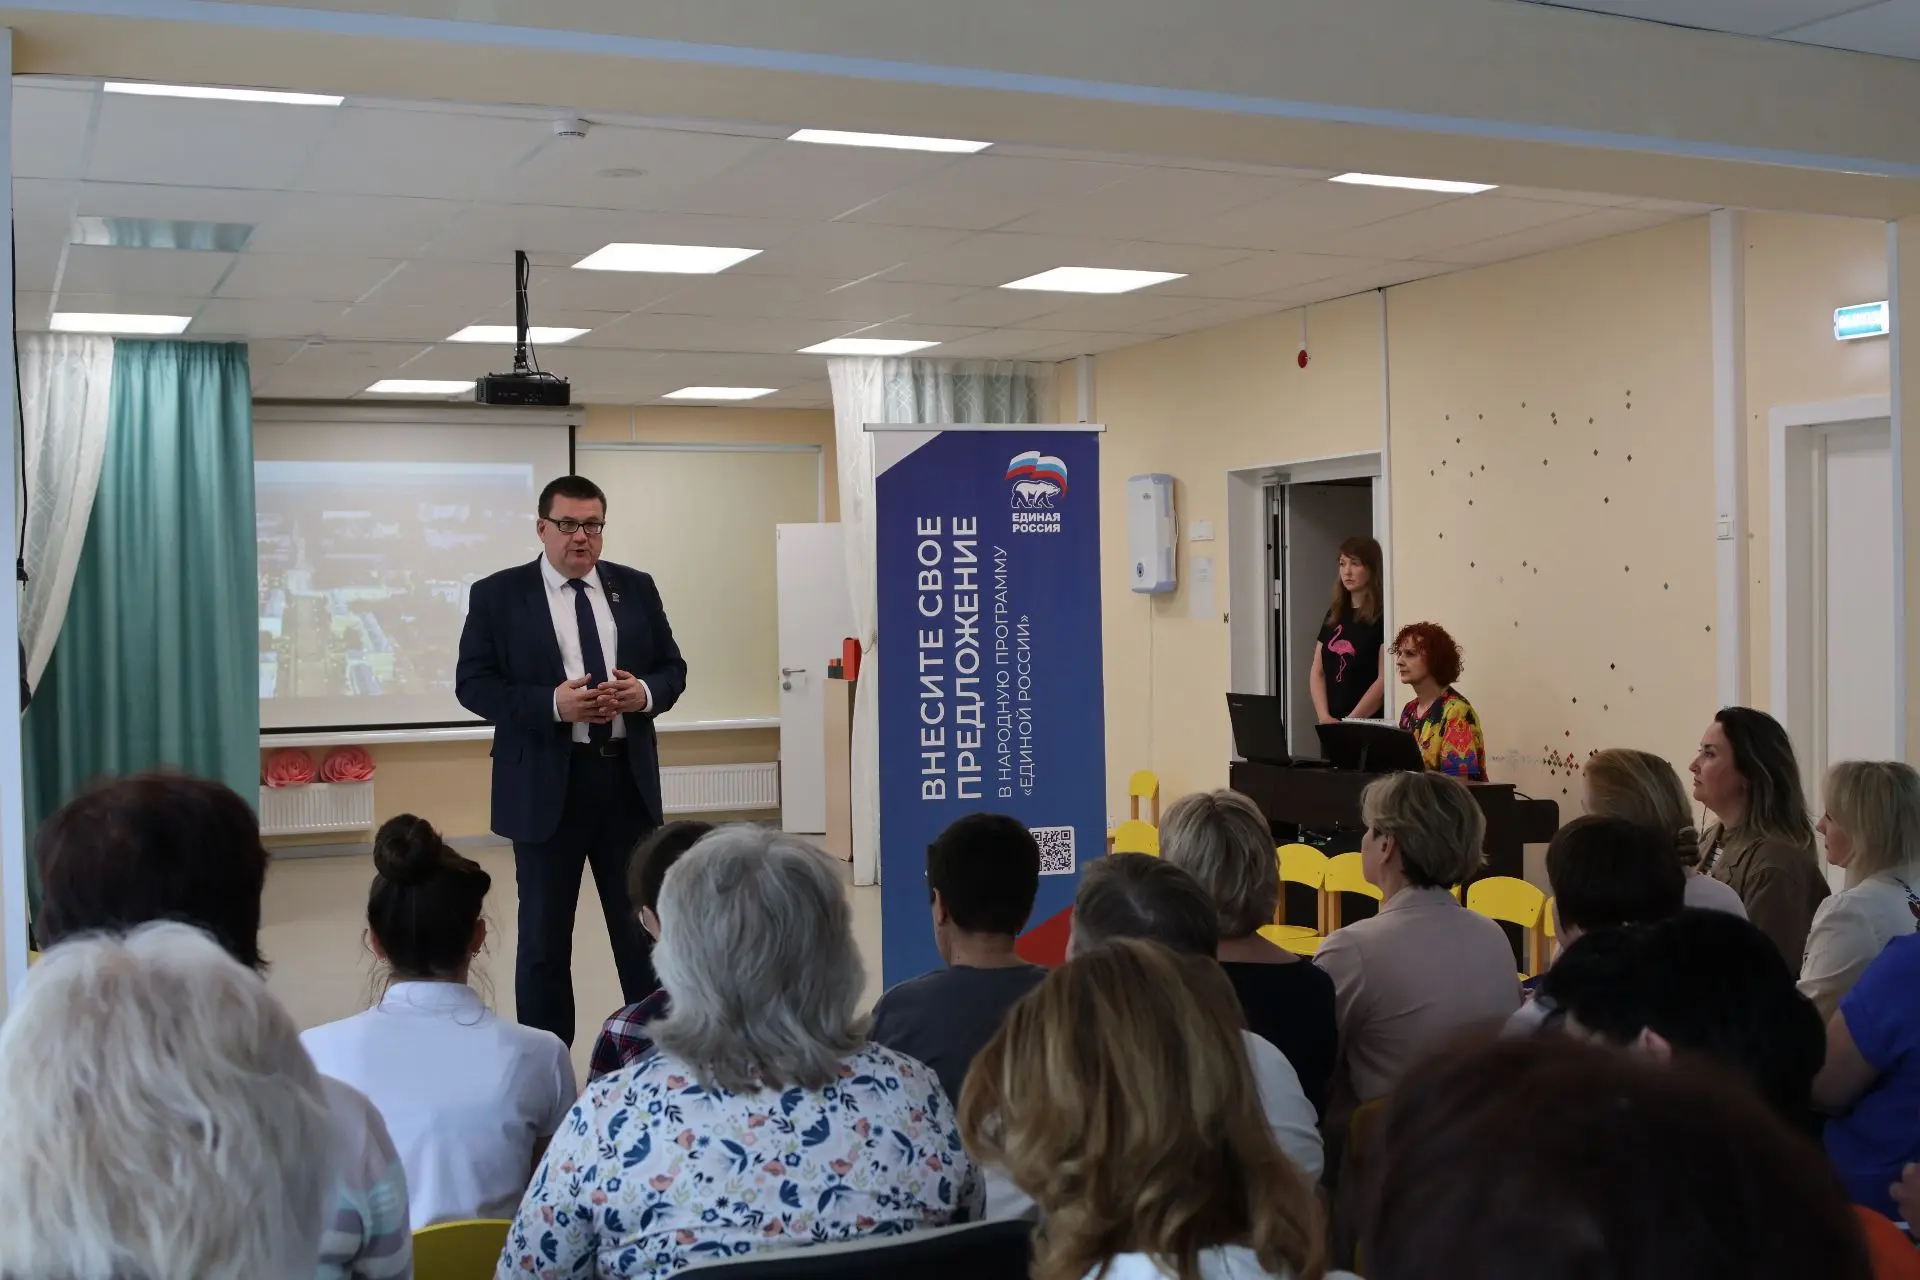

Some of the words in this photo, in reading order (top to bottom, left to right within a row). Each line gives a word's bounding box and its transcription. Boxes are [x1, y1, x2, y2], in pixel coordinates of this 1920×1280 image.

[1011, 512, 1061, 524] ЕДИНАЯ
[1012, 523, 1061, 533] РОССИЯ
[916, 516, 943, 617] СВОЕ
[993, 545, 1009, 665] ПРОГРАММУ
[952, 516, 986, 799] ПРЕДЛОЖЕНИЕ
[1016, 614, 1032, 701] РОССИИ»
[918, 629, 946, 801] ВНЕСИТЕ
[996, 670, 1013, 780] НАРОДНУЮ
[1015, 707, 1036, 796] «ЕДИНОЙ
[998, 786, 1012, 798] В
